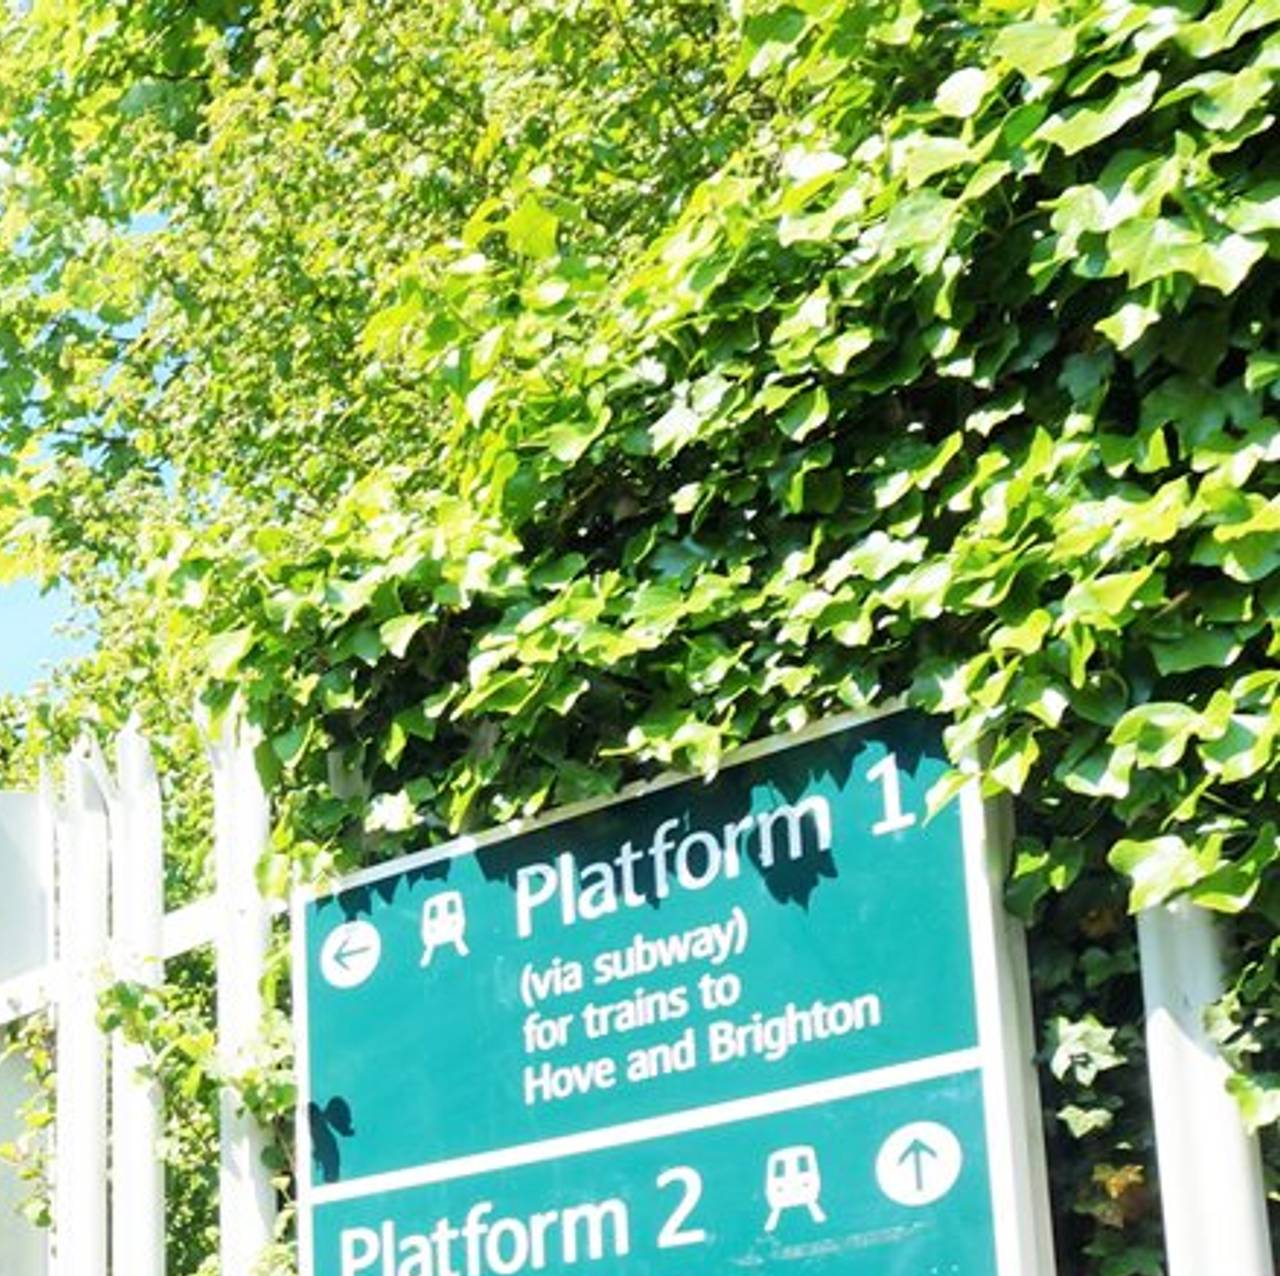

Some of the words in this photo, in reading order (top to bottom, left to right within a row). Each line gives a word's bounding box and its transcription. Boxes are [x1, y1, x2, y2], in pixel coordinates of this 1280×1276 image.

[515, 795, 832, 938] Platform
[867, 754, 916, 837] 1
[520, 957, 583, 1008] (via
[594, 906, 748, 984] subway)
[523, 1012, 573, 1053] for
[582, 986, 689, 1039] trains
[698, 973, 741, 1010] to
[524, 1058, 616, 1105] Hove
[627, 1027, 696, 1082] and
[708, 994, 881, 1063] Brighton
[656, 1166, 706, 1248] 2
